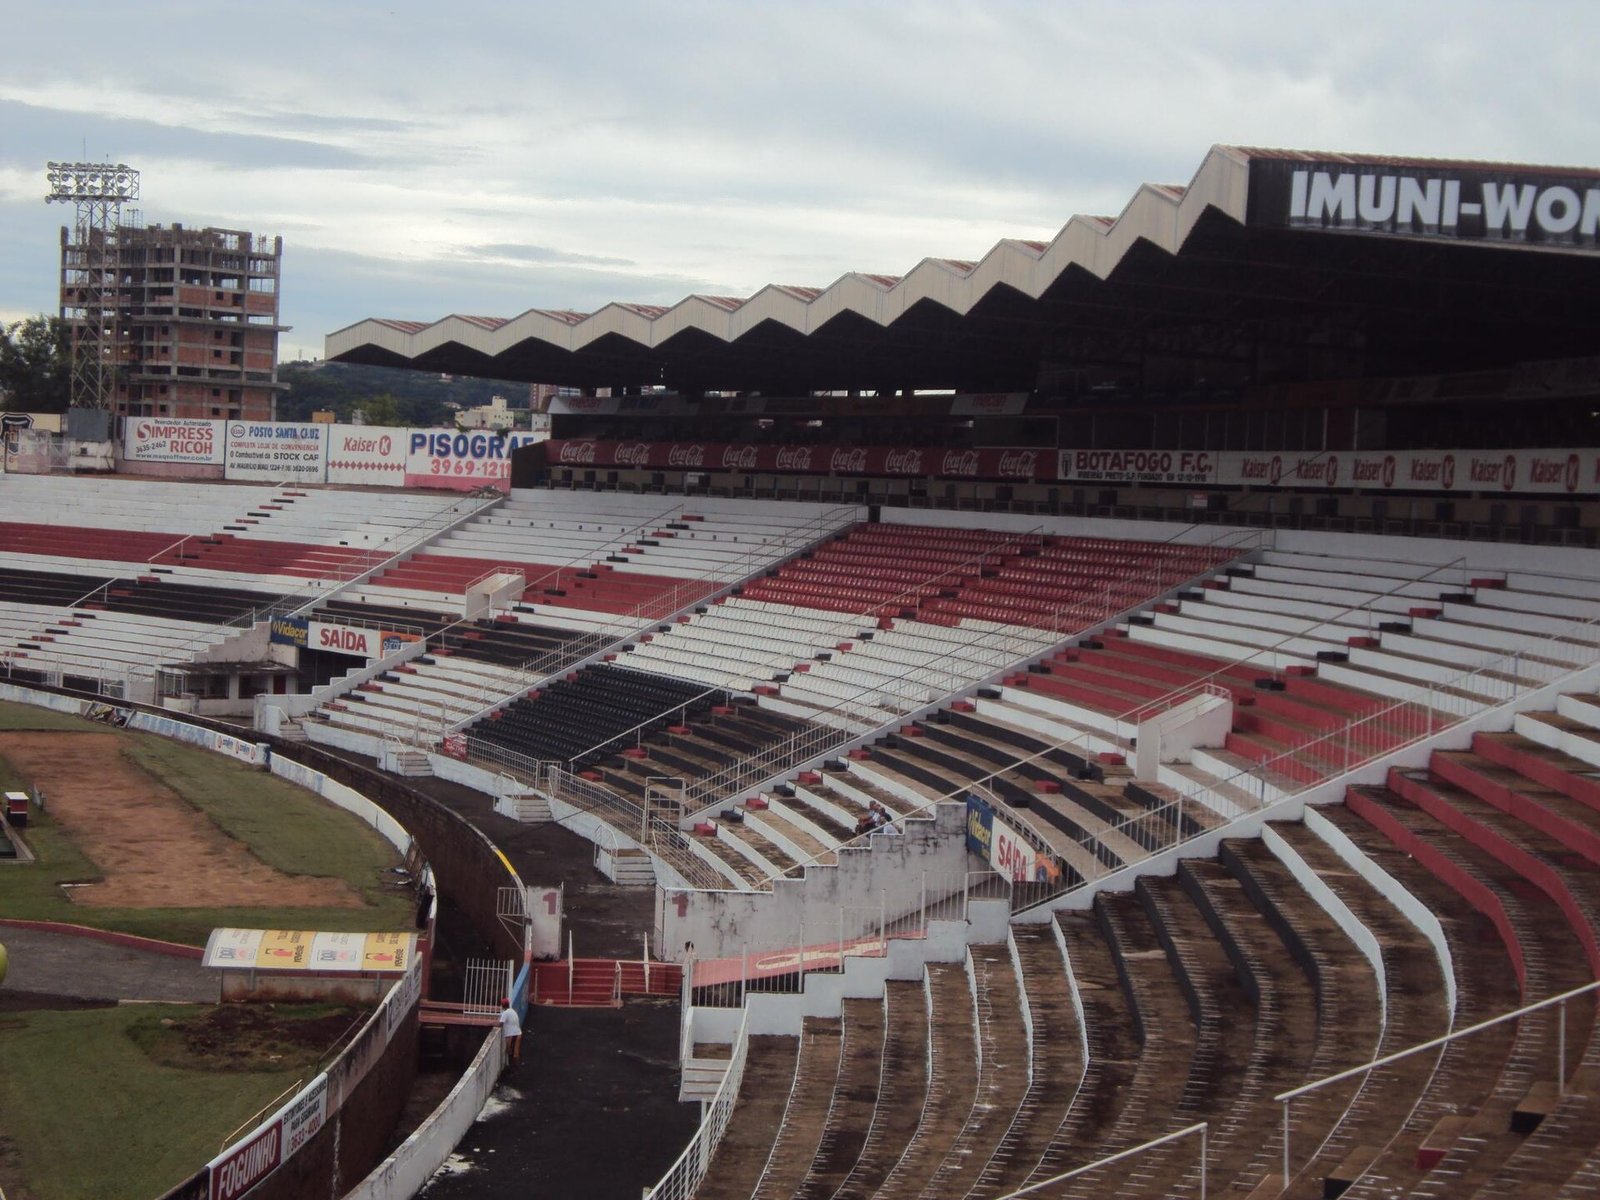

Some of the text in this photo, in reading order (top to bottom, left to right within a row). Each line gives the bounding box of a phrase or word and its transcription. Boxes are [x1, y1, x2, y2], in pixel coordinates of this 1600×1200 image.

[249, 426, 273, 438] POSTO
[275, 427, 298, 439] SANTA
[170, 440, 213, 454] RICOH
[344, 437, 377, 452] Kaiser
[1076, 451, 1212, 473] BOTAFOGO F.C.
[1241, 458, 1270, 478] Kaiser
[1296, 458, 1326, 480] Kaiser
[1352, 458, 1382, 481] Kaiser
[1411, 458, 1441, 481] Kaiser
[1470, 457, 1502, 482] Kaiser
[1530, 457, 1565, 483] Kaiser
[320, 627, 367, 652] SAÍDA
[542, 892, 557, 915] 1
[672, 893, 688, 917] 1
[217, 1127, 277, 1200] FOGUINHO
